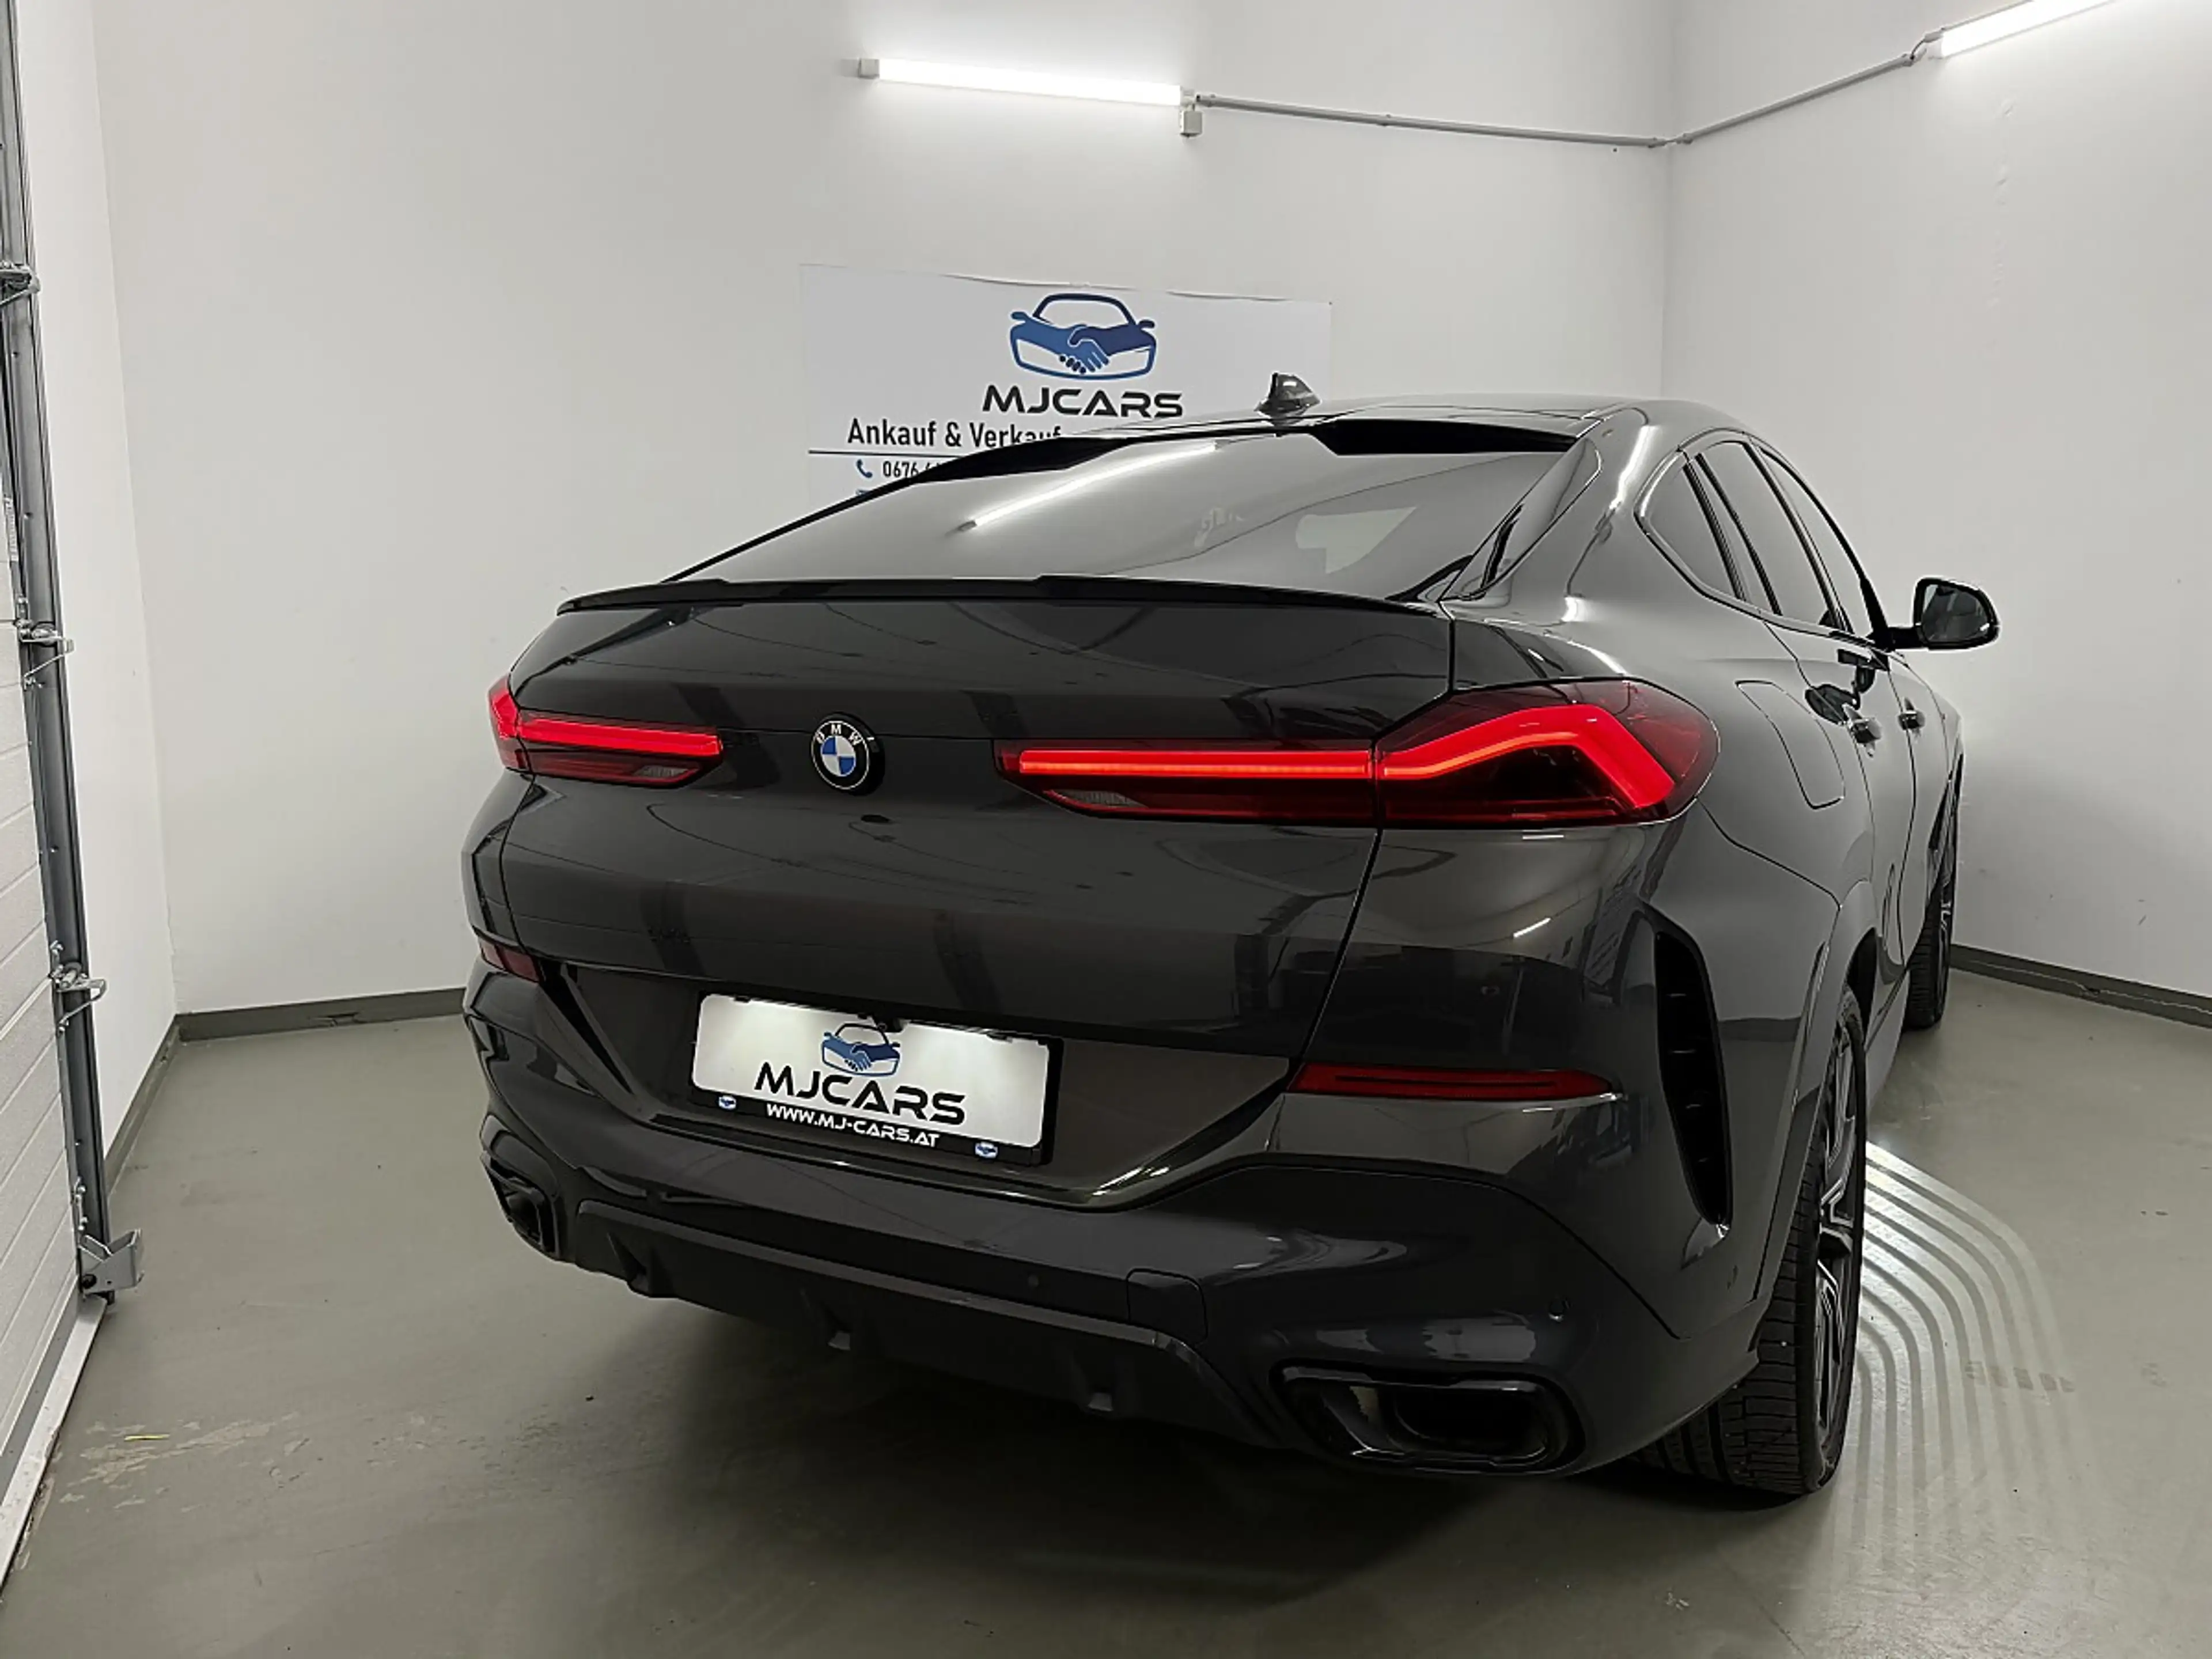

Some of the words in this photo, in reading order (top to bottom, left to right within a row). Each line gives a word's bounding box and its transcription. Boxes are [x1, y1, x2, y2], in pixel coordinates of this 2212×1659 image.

[982, 384, 1183, 419] MJCARS
[847, 418, 937, 446] Ankauf
[945, 422, 961, 448] &
[816, 724, 863, 745] BMW
[754, 1061, 965, 1126] MJCARS
[766, 1103, 940, 1148] WWW.MJ-CARS.AT
